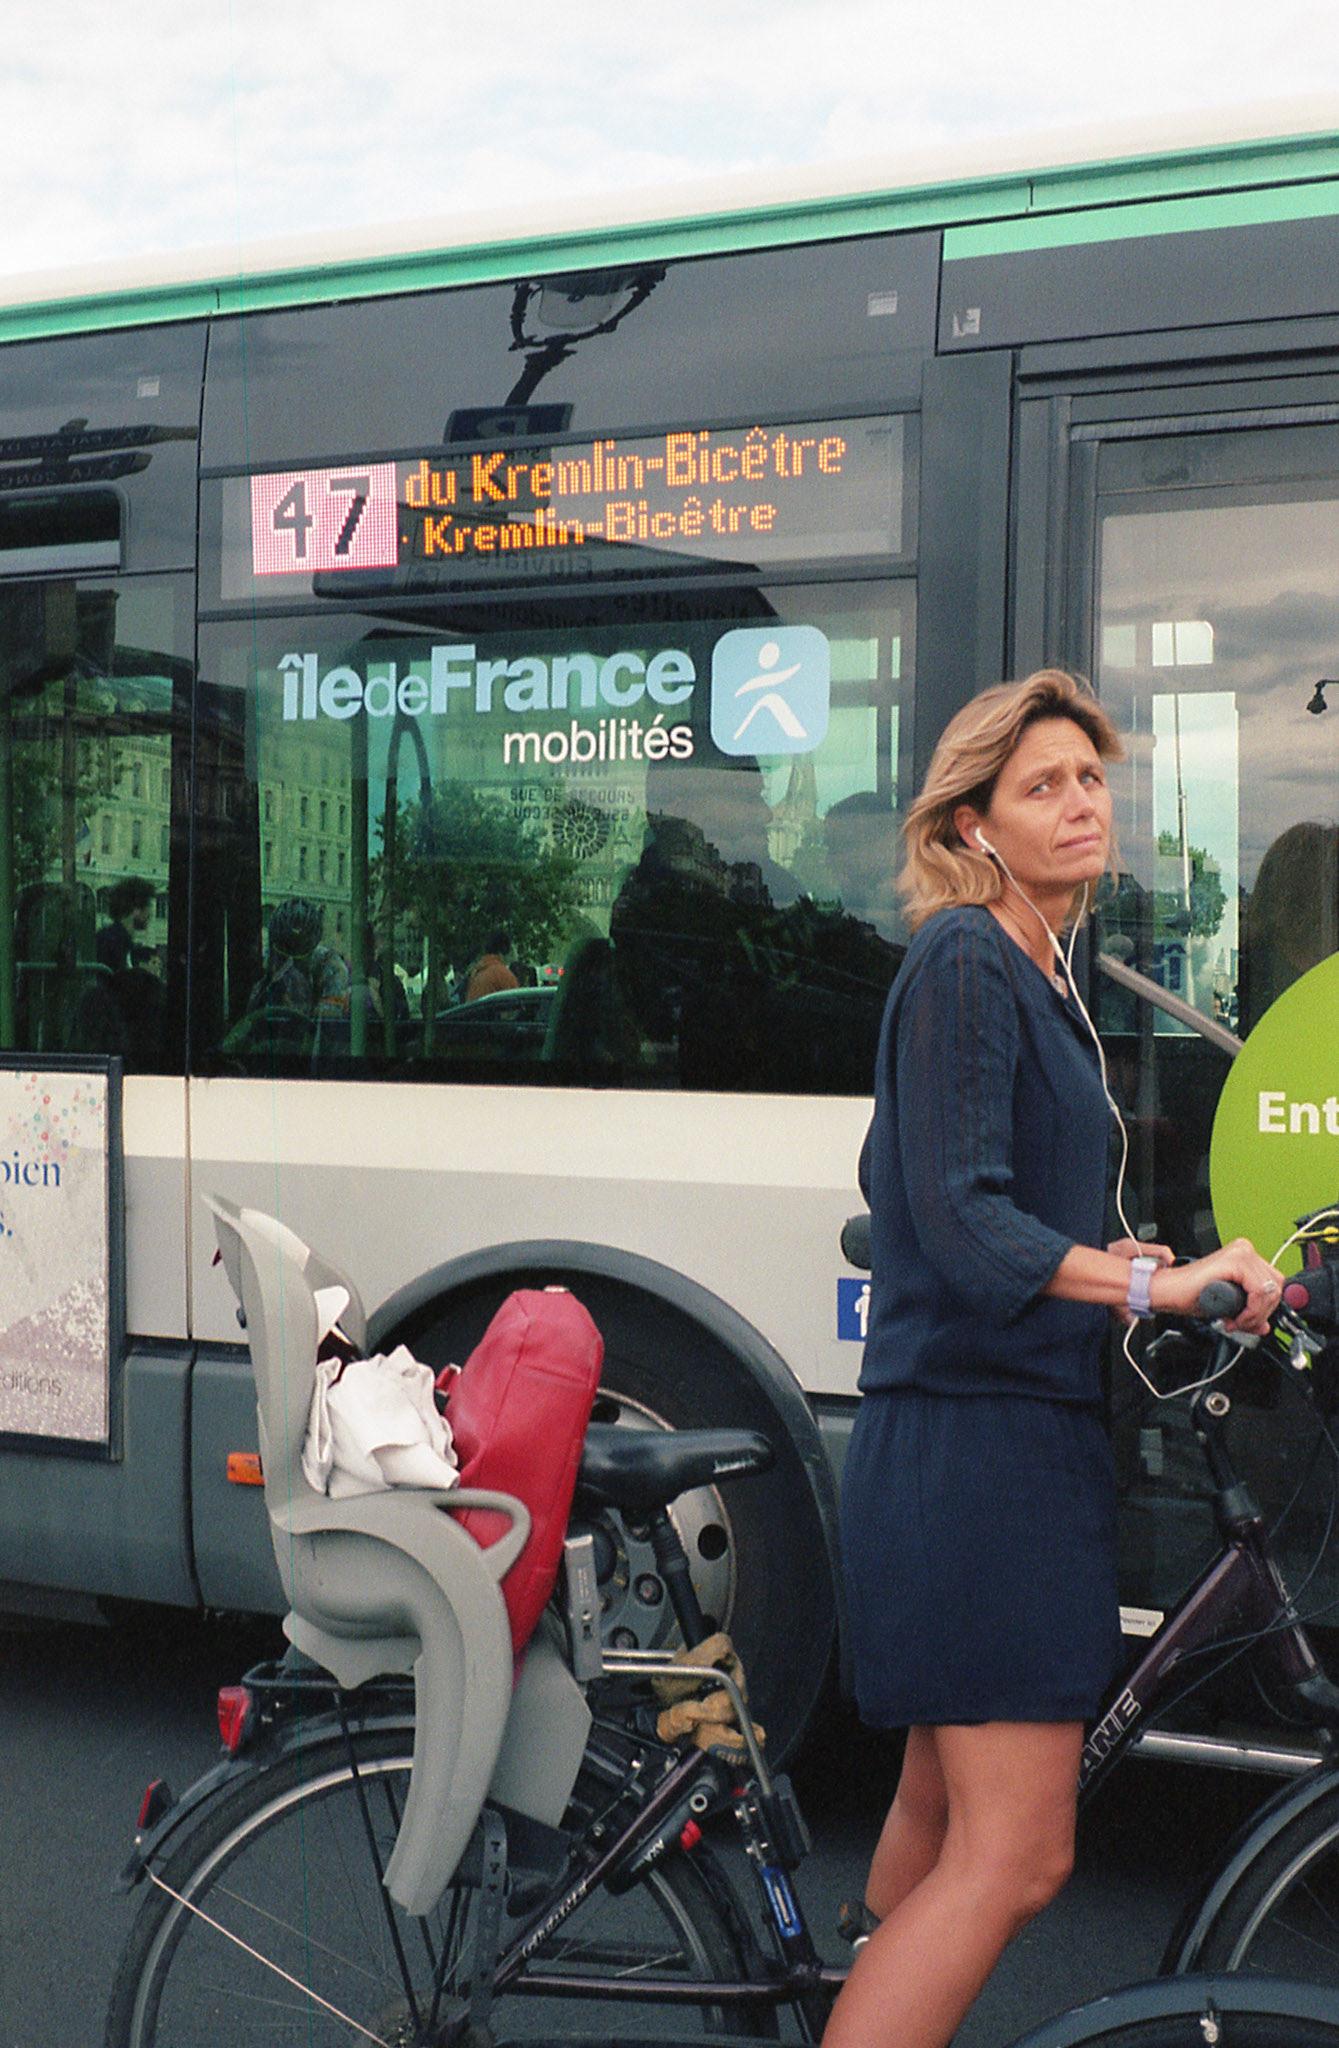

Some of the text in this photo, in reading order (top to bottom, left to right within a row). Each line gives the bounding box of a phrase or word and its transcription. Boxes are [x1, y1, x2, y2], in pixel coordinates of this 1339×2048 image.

[405, 425, 846, 507] du Kremlin-Bicêtre
[274, 476, 370, 559] 47
[423, 496, 777, 555] Kremlin-Bicêtre
[503, 713, 694, 765] mobilités
[1258, 1091, 1339, 1135] Ent
[0, 1371, 62, 1397] ditions
